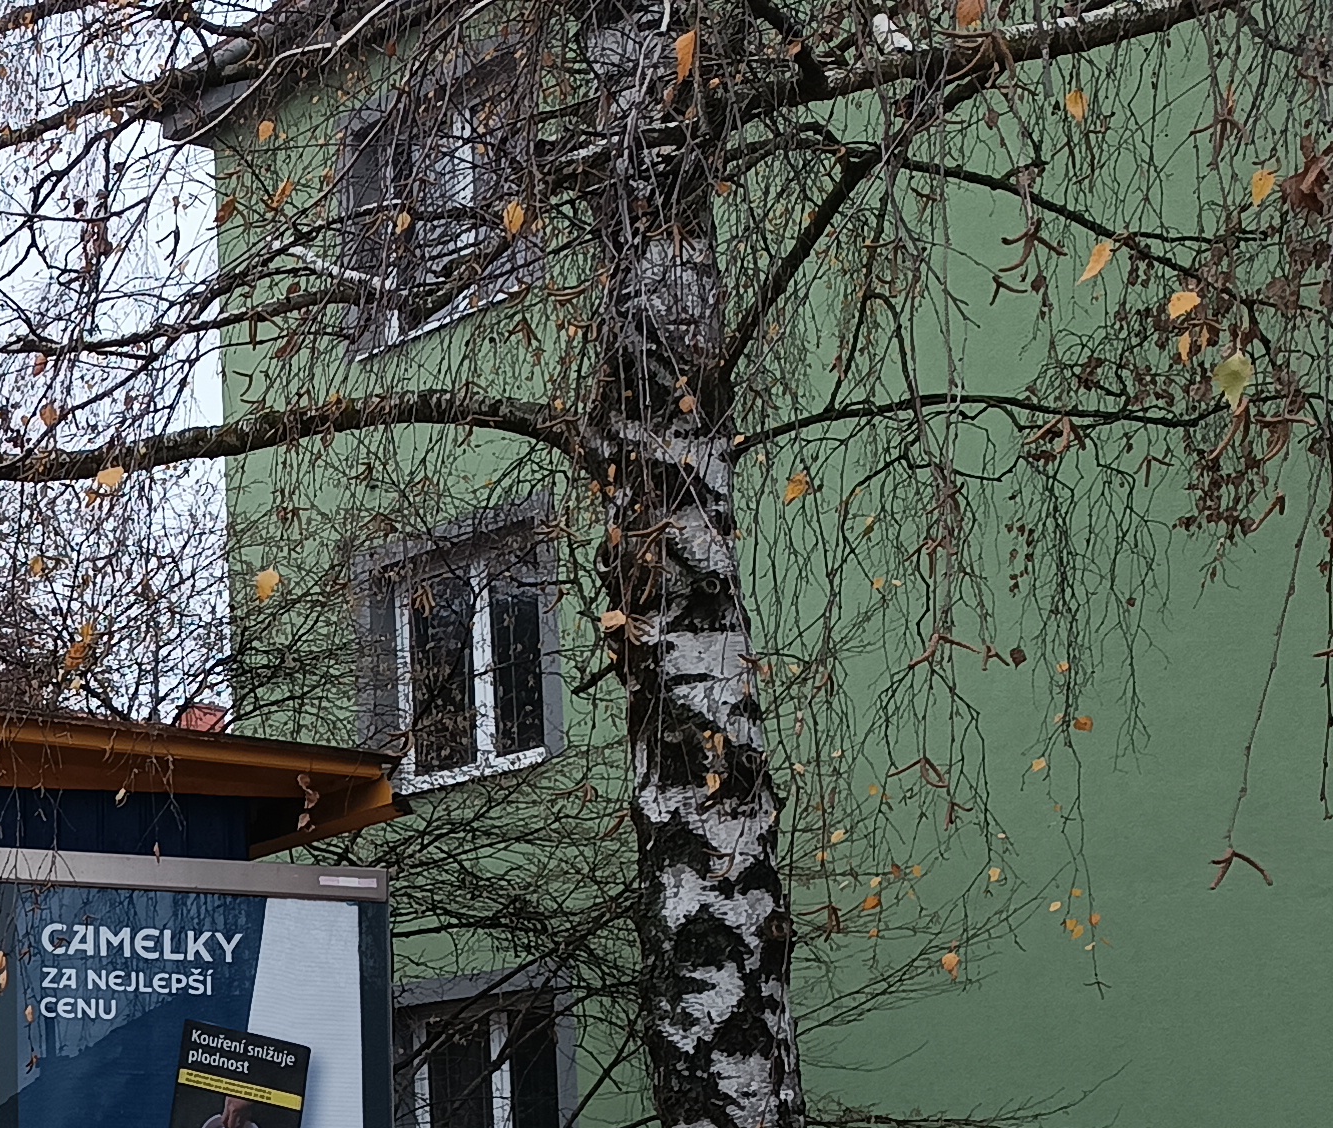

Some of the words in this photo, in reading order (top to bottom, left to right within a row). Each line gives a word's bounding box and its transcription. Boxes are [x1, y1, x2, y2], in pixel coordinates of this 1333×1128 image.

[41, 922, 244, 963] CAMELKY
[41, 967, 77, 990] ZA
[87, 968, 214, 996] NEJLEPŠÍ
[40, 996, 117, 1021] CENU
[188, 1048, 250, 1074] plodnost
[191, 1029, 247, 1054] Kouření
[247, 1045, 296, 1068] snižuje
